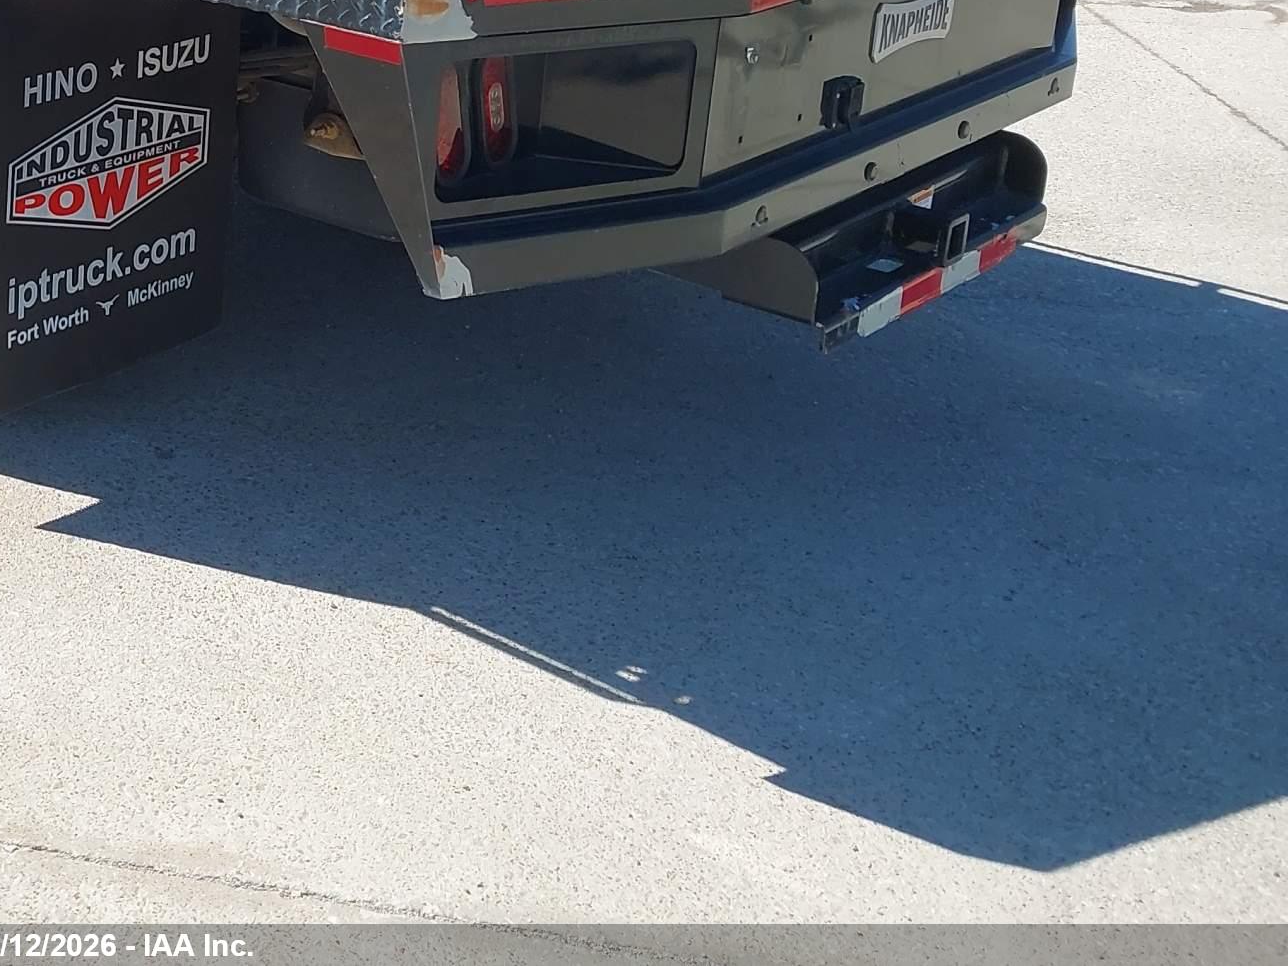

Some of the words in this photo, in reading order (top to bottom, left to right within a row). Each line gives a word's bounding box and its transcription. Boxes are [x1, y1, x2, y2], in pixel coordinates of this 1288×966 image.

[23, 62, 98, 108] HINO
[137, 33, 212, 80] ISUZU
[16, 106, 203, 181] INDUSTRIAL
[39, 165, 87, 188] TRUCK
[90, 161, 100, 174] &
[104, 139, 182, 170] EQUIPMENT
[14, 146, 202, 220] POWER
[7, 228, 197, 320] iptruck.com
[7, 323, 40, 349] Fort
[43, 305, 90, 337] Worth
[127, 269, 195, 308] McKinney
